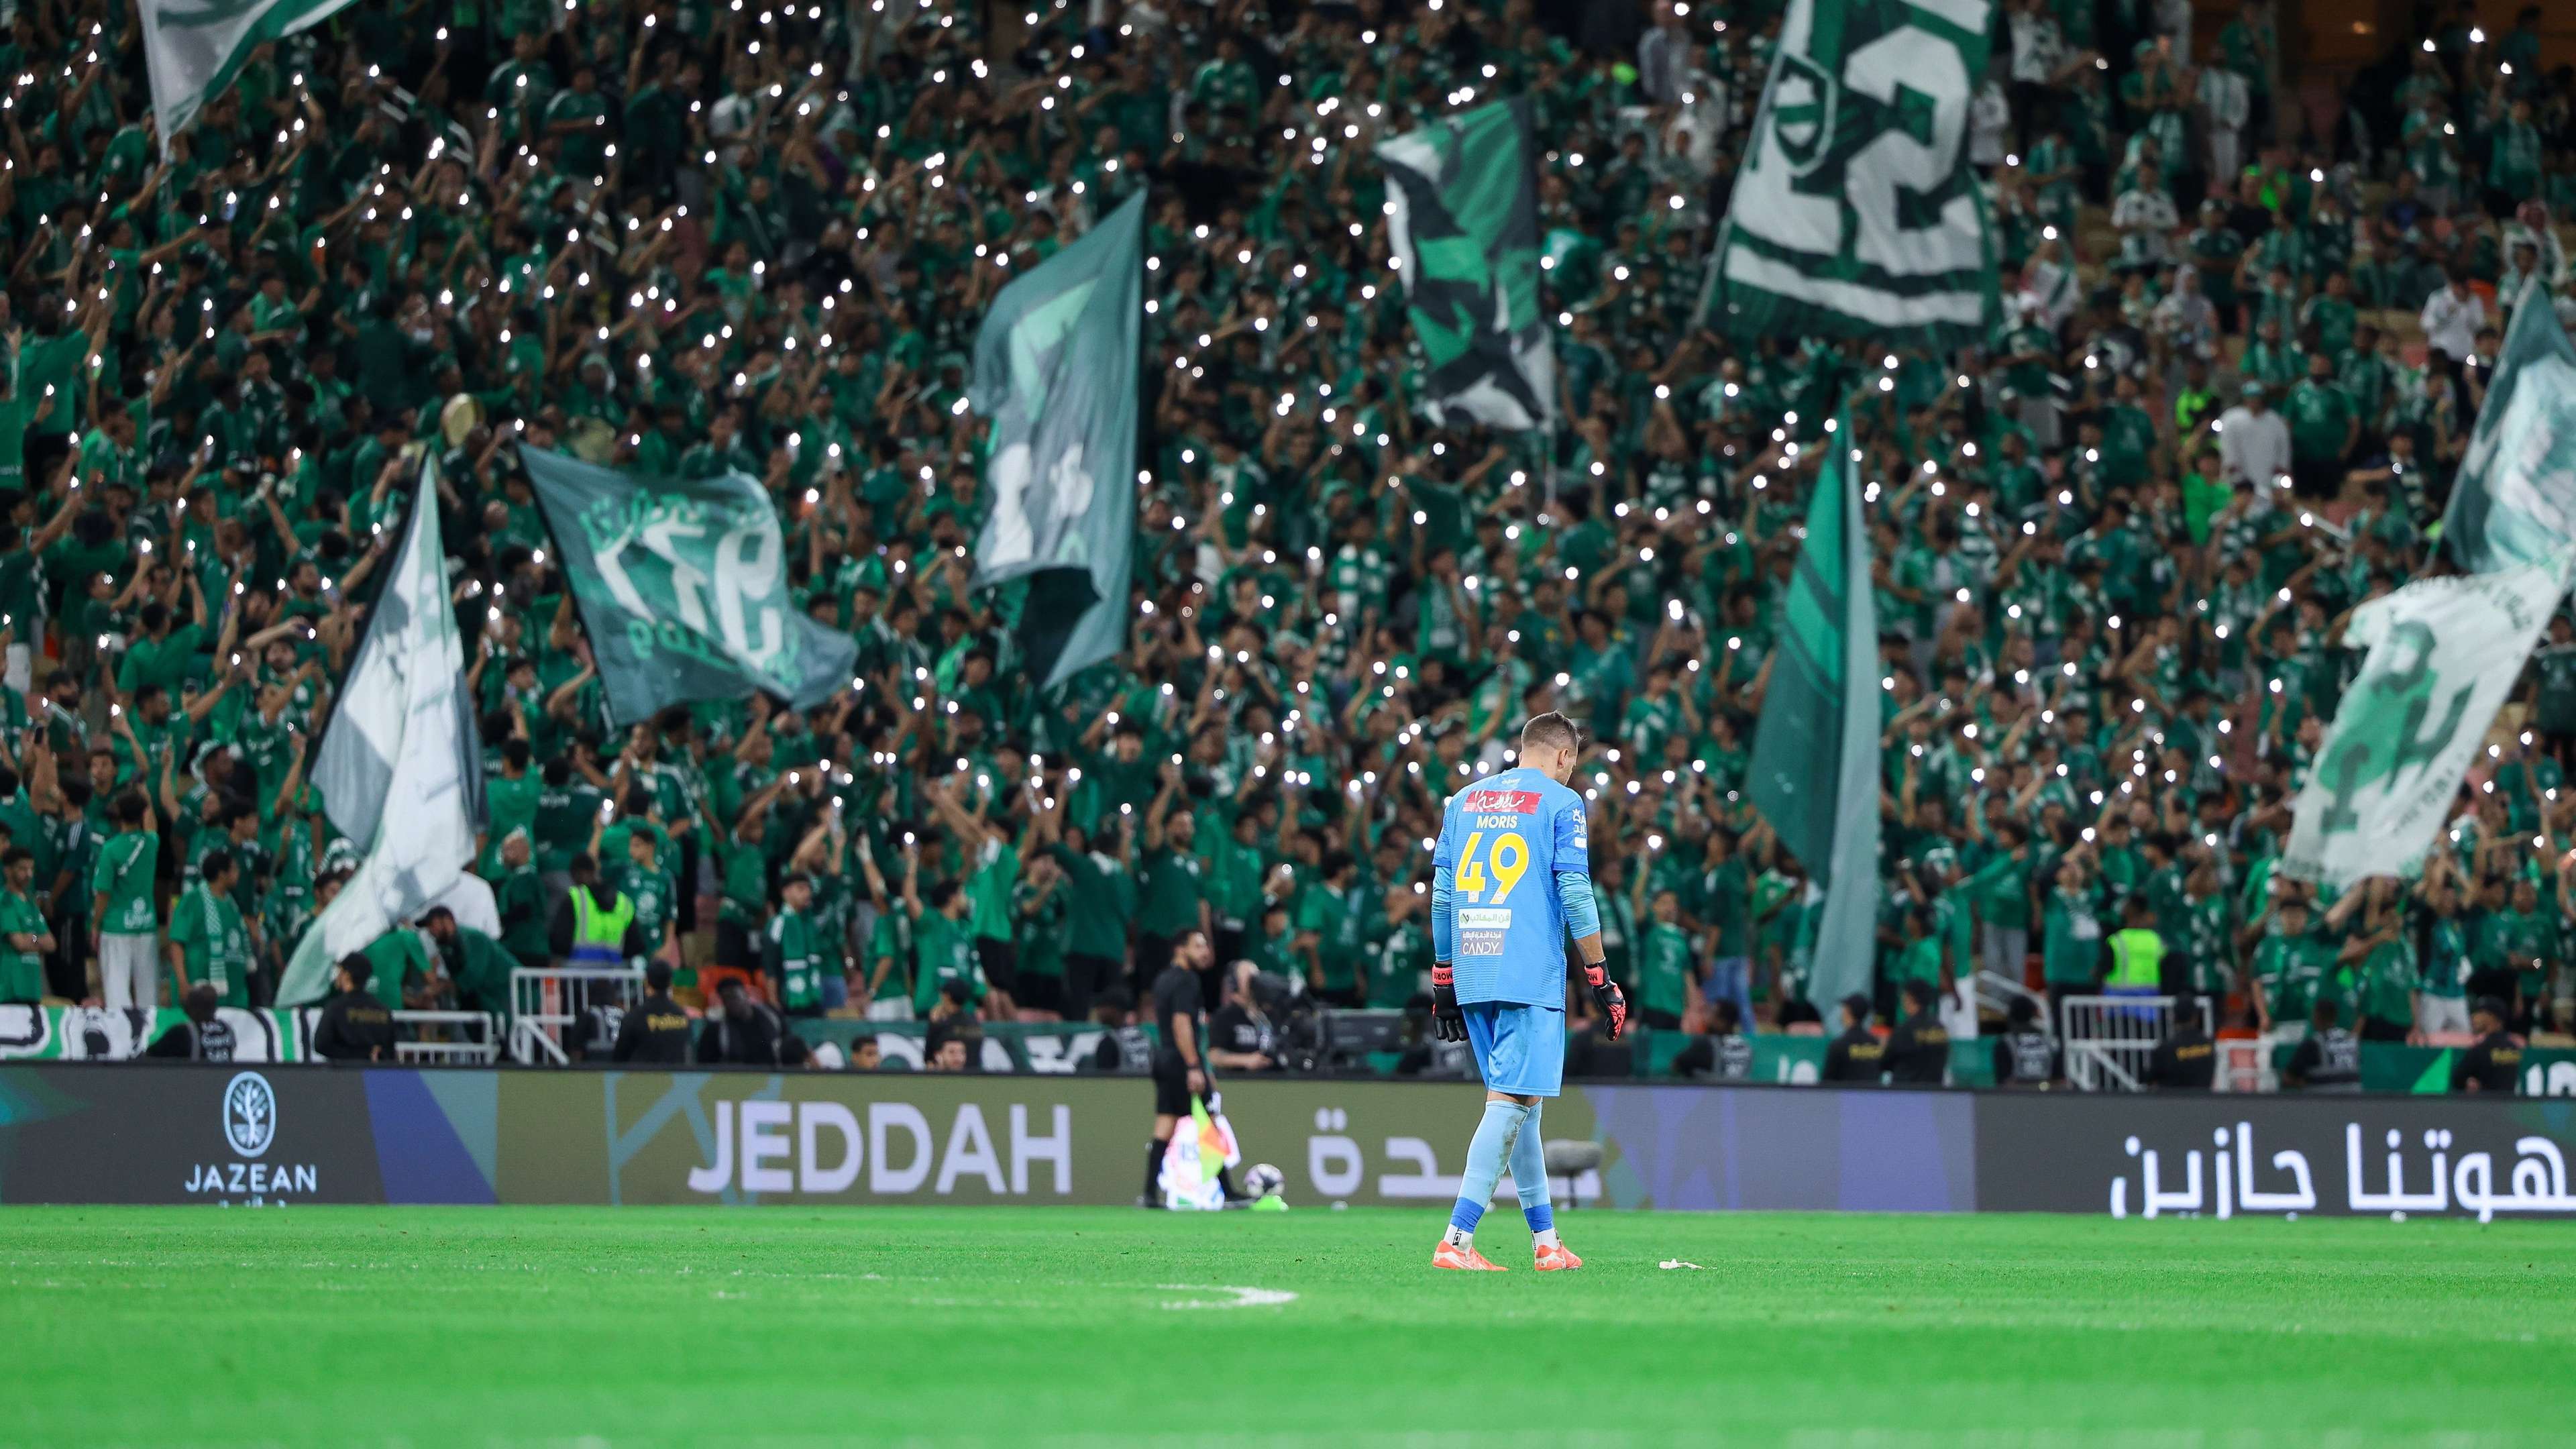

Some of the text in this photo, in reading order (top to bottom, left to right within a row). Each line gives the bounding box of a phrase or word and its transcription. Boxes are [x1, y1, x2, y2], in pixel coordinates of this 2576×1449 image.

[1476, 815, 1518, 828] MORIS
[1455, 832, 1529, 904] 49
[1462, 942, 1499, 955] CANDY
[688, 1100, 1072, 1195] JEDDAH
[2347, 1122, 2576, 1223] هوتنا
[184, 1163, 317, 1193] JAZEAN
